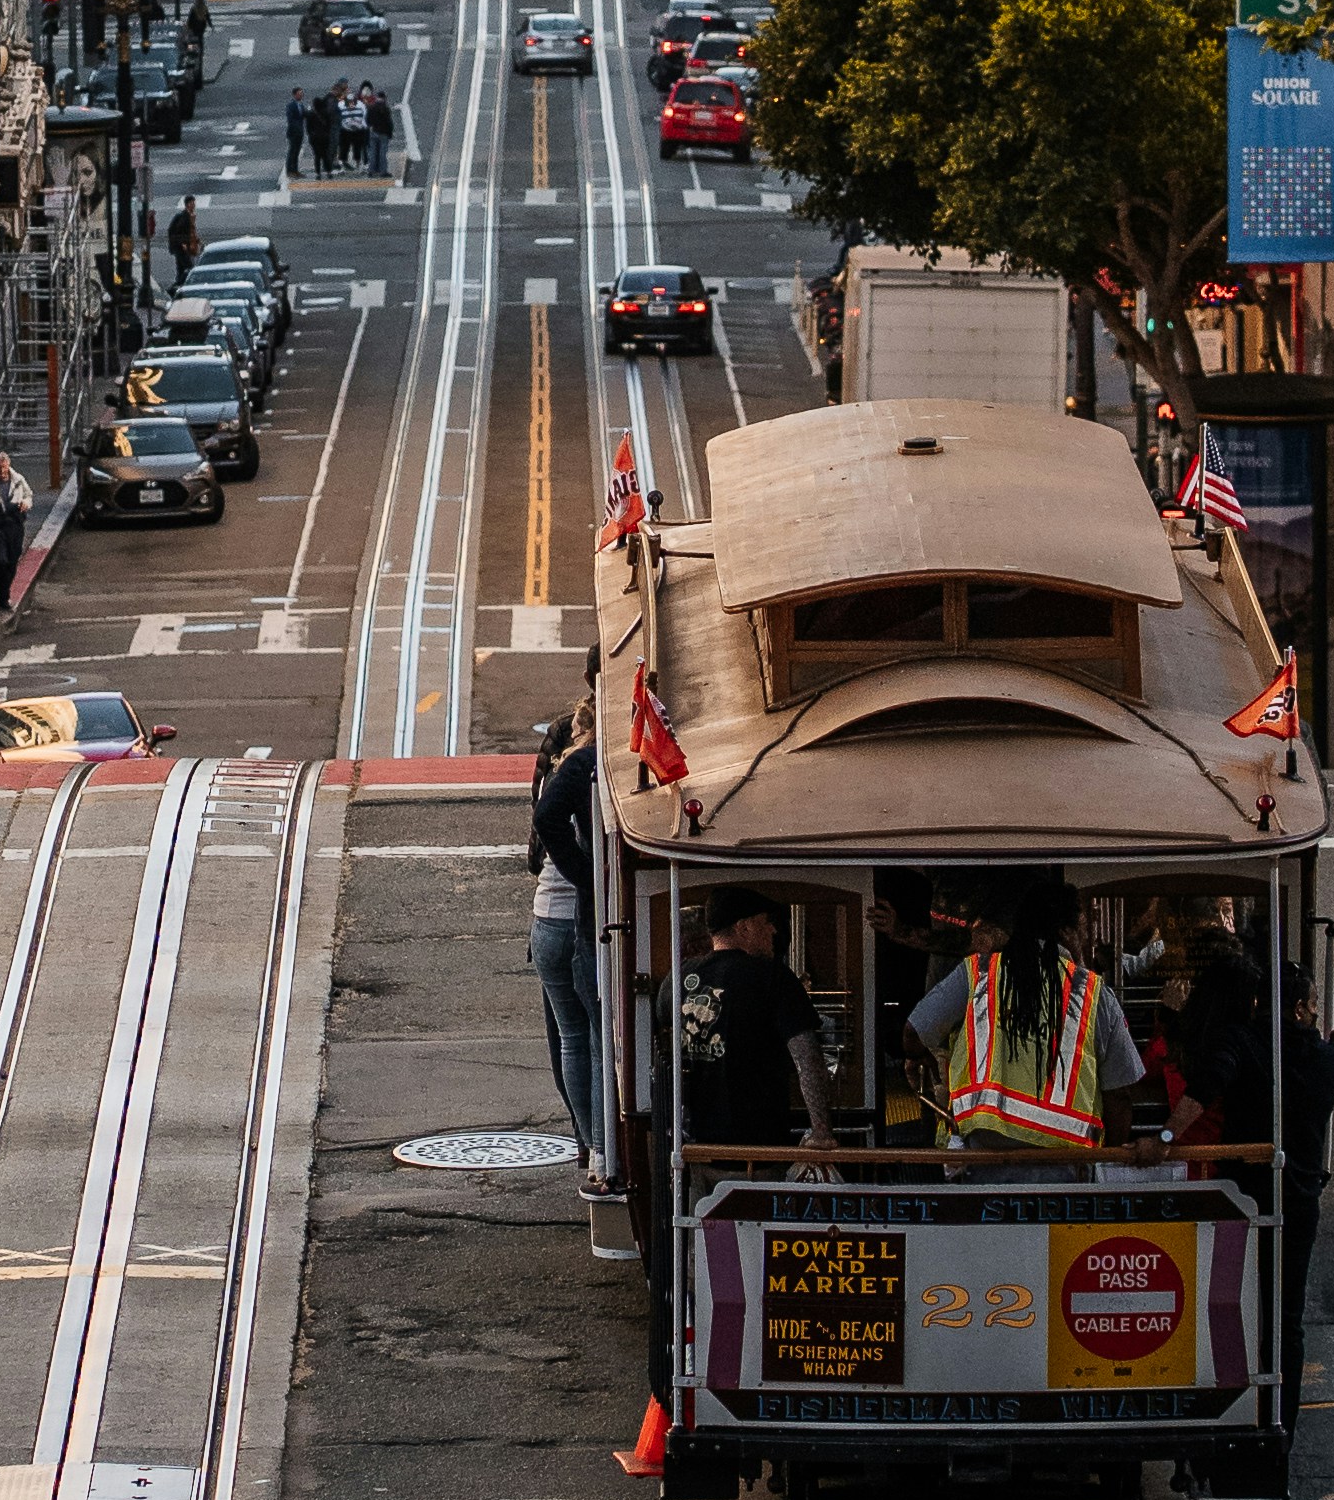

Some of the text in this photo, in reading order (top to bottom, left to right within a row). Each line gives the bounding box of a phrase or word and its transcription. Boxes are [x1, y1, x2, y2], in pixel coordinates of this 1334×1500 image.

[1263, 77, 1311, 89] UNION
[1252, 89, 1322, 106] SQUARE
[771, 1196, 939, 1222] MARKET
[980, 1195, 1145, 1222] STREET
[771, 1239, 898, 1260] POWELL
[804, 1260, 866, 1275] AND
[1086, 1254, 1161, 1272] DO NOT
[769, 1277, 899, 1295] MARKET
[1098, 1271, 1149, 1290] PASS
[768, 1320, 811, 1341] HYDE
[839, 1319, 896, 1343] BEACH
[1074, 1316, 1172, 1334] CABLE CAR
[778, 1345, 884, 1361] FISHERMANS
[803, 1362, 857, 1376] WHARF
[757, 1392, 1195, 1421] FISHERMANS WHARF
